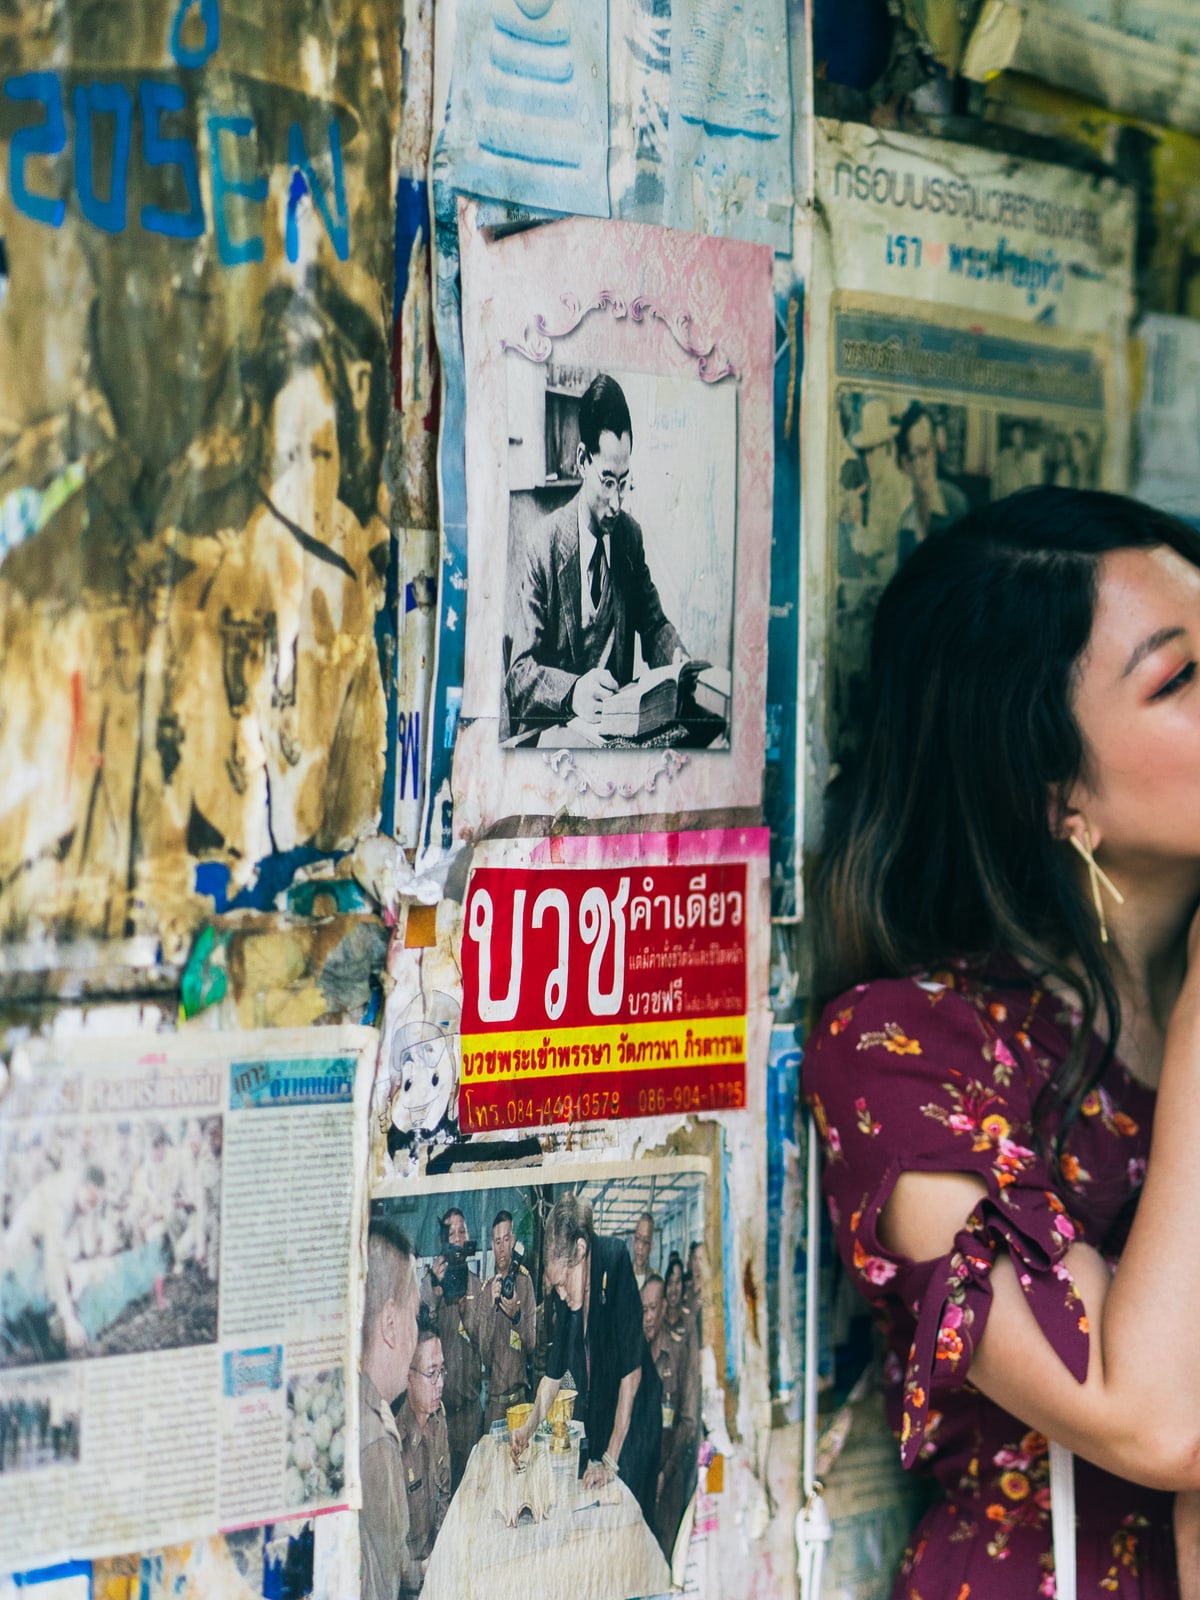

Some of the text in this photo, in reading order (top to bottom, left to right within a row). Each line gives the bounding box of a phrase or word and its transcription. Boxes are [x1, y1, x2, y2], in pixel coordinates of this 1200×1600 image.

[629, 873, 742, 931] คำเดียว
[468, 877, 631, 1023] บวช
[628, 976, 683, 1015] บวชฟรี
[463, 1036, 611, 1076] บวชพระเข้าพรรษา
[617, 1032, 679, 1064] วัดภาวนา
